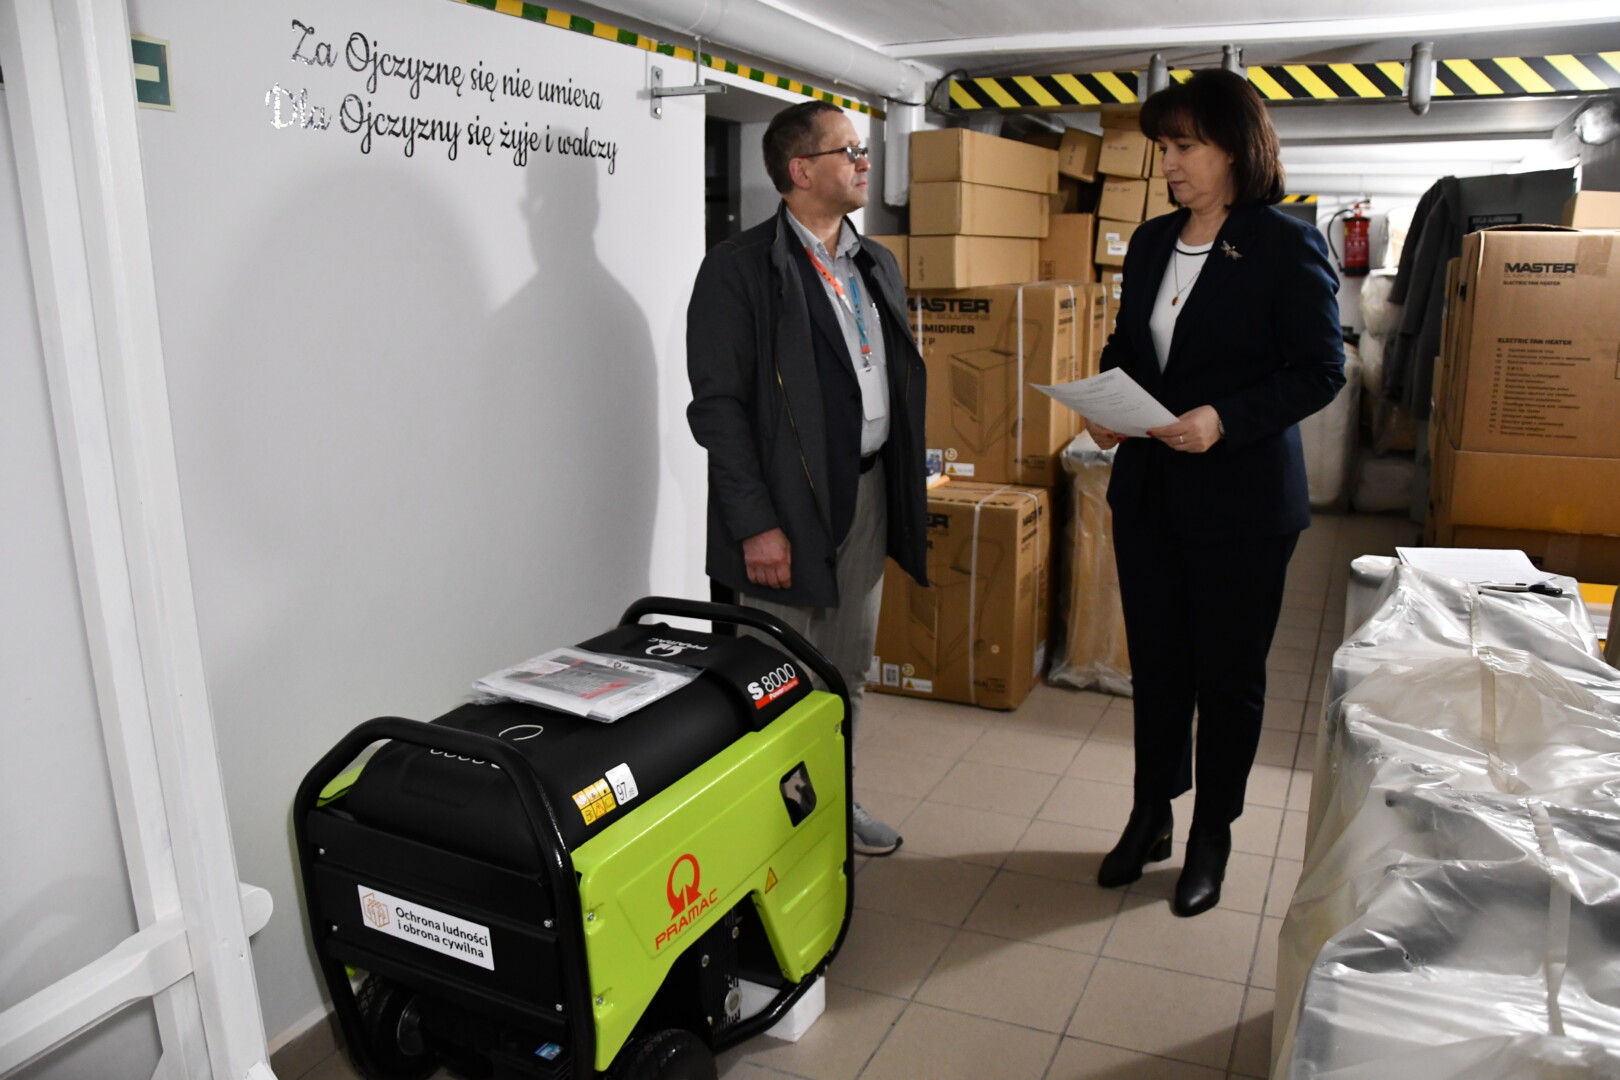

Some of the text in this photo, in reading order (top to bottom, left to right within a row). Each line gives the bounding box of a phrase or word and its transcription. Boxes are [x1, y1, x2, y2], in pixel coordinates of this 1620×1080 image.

[291, 19, 603, 110] Za Ojczyznę się nie umiera
[265, 82, 618, 174] Dla Ojczyzny się żyje i walczy
[1504, 263, 1576, 274] MASTER
[747, 663, 796, 701] S 8000
[616, 782, 628, 801] 97
[395, 906, 488, 947] Ochrona ludności
[397, 919, 485, 959] i obrona cywilna
[655, 888, 718, 950] PRAMAC
